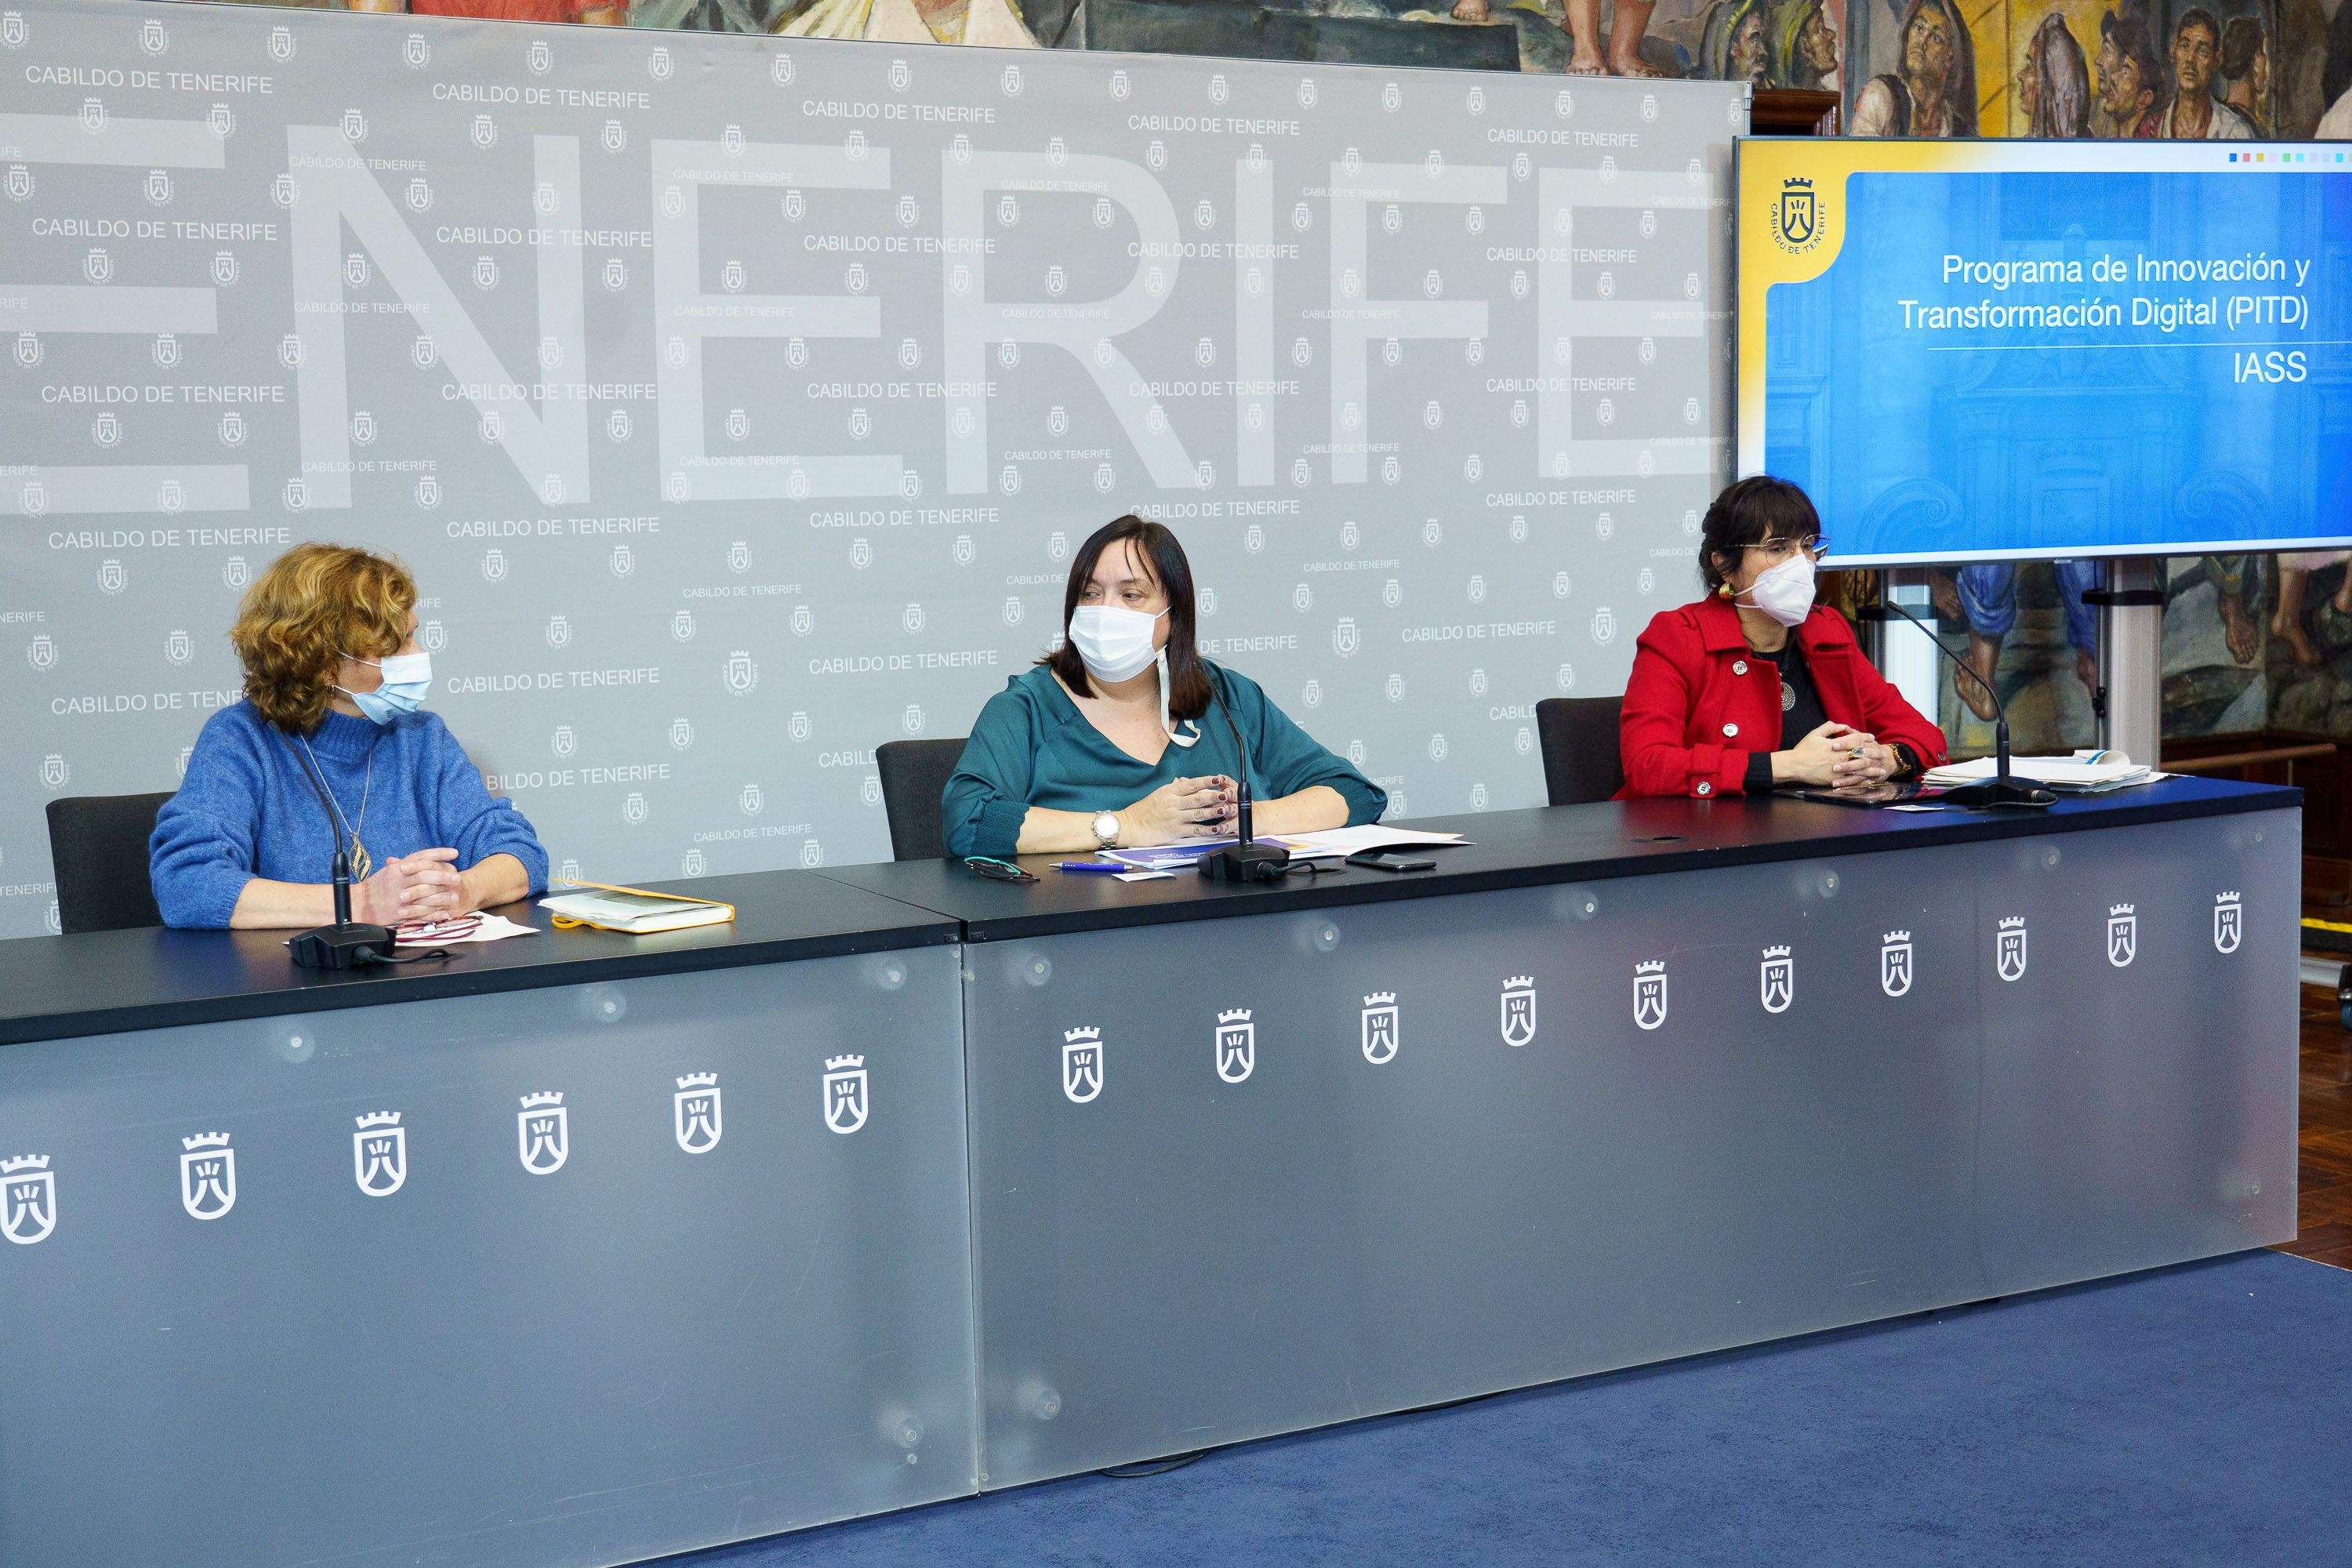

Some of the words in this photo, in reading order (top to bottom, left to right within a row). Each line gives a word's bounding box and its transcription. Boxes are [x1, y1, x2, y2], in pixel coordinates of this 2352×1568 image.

[24, 64, 125, 88] CABILDO
[130, 69, 162, 89] DE
[166, 71, 274, 95] TENERIFE
[432, 83, 520, 103] CABILDO
[524, 87, 552, 105] DE
[556, 89, 651, 109] TENERIFE
[802, 100, 880, 119] CABILDO
[884, 103, 908, 121] DE
[911, 104, 996, 124] TENERIFE
[1127, 114, 1197, 132] CABILDO
[1200, 117, 1222, 133] DE
[1225, 118, 1301, 136] TENERIFE
[1486, 128, 1548, 144] CABILDO
[1550, 129, 1570, 146] DE
[1573, 131, 1639, 148] TENERIFE
[289, 155, 344, 169] CABILDO
[347, 158, 364, 170] DE
[366, 158, 427, 172] TENERIFE
[670, 169, 722, 181] CABILDO
[723, 170, 740, 182] DE
[741, 170, 795, 183] TENERIFE
[1000, 179, 1046, 191] CABILDO
[1046, 180, 1061, 191] DE
[1062, 180, 1110, 192] TENERIFE
[1301, 187, 1341, 198] CABILDO
[1343, 187, 1356, 198] DE
[1358, 188, 1399, 199] TENERIFE
[31, 218, 130, 238] CABILDO
[136, 220, 167, 238] DE
[171, 221, 278, 241] TENERIFE
[435, 226, 523, 245] CABILDO
[528, 228, 554, 246] DE
[560, 229, 653, 248] TENERIFE
[1770, 202, 1787, 250] CABILDO
[1788, 245, 1800, 255] DE
[1802, 201, 1826, 254] TENERIFE
[803, 234, 881, 252] CABILDO
[884, 236, 909, 252] DE
[913, 236, 996, 254] TENERIFE
[1127, 241, 1197, 258] CABILDO
[1200, 242, 1221, 258] DE
[1224, 243, 1300, 260] TENERIFE
[1486, 247, 1547, 263] CABILDO
[1550, 247, 1568, 263] DE
[1572, 248, 1637, 263] TENERIFE
[1942, 254, 2083, 292] Programa
[2091, 253, 2128, 283] de
[2137, 252, 2287, 283] Innovación
[2294, 258, 2311, 288] y
[294, 301, 349, 314] CABILDO
[350, 302, 368, 314] DE
[370, 302, 430, 314] TENERIFE
[673, 306, 724, 317] CABILDO
[725, 306, 741, 318] DE
[742, 307, 796, 318] TENERIFE
[1001, 308, 1046, 319] CABILDO
[1046, 308, 1061, 319] DE
[1062, 308, 1110, 319] TENERIFE
[1301, 310, 1341, 319] CABILDO
[1342, 309, 1355, 319] DE
[1356, 309, 1399, 319] TENERIFE
[1897, 297, 2122, 329] Transformación
[2132, 296, 2217, 333] Digital
[2226, 295, 2310, 332] (PITD)
[2234, 351, 2307, 383] IASS
[441, 383, 528, 401] CABILDO
[532, 383, 559, 401] DE
[564, 383, 657, 400] TENERIFE
[806, 383, 884, 399] CABILDO
[887, 382, 911, 398] DE
[914, 382, 998, 397] TENERIFE
[1129, 381, 1198, 397] CABILDO
[1200, 380, 1222, 397] DE
[1225, 379, 1300, 395] TENERIFE
[1486, 378, 1546, 393] CABILDO
[1549, 376, 1568, 393] DE
[1571, 376, 1637, 391] TENERIFE
[40, 385, 139, 403] CABILDO
[144, 385, 175, 403] DE
[179, 385, 285, 403] TENERIFE
[1004, 450, 1048, 461] CABILDO
[1048, 449, 1063, 460] DE
[1064, 448, 1112, 459] TENERIFE
[1302, 445, 1341, 454] CABILDO
[1343, 443, 1355, 454] DE
[1357, 442, 1400, 452] TENERIFE
[302, 461, 356, 473] CABILDO
[358, 460, 376, 472] DE
[377, 459, 437, 471] TENERIFE
[679, 456, 728, 467] CABILDO
[729, 456, 746, 466] DE
[747, 456, 800, 466] TENERIFE
[0, 466, 38, 477] ERIFE
[1485, 491, 1547, 507] CABILDO
[1548, 491, 1568, 506] DE
[1570, 488, 1636, 505] TENERIFE
[808, 510, 886, 528] CABILDO
[889, 510, 913, 527] DE
[916, 506, 1000, 525] TENERIFE
[1129, 503, 1198, 520] CABILDO
[1201, 502, 1223, 517] DE
[1225, 499, 1301, 517] TENERIFE
[445, 519, 532, 539] CABILDO
[536, 518, 564, 536] DE
[567, 516, 660, 535] TENERIFE
[48, 530, 145, 550] CABILDO
[151, 529, 181, 547] DE
[186, 527, 291, 546] TENERIFE
[1302, 561, 1343, 572] CABILDO
[1343, 560, 1356, 572] DE
[1357, 558, 1400, 570] TENERIFE
[1006, 575, 1049, 585] CABILDO
[1051, 573, 1065, 583] DE
[682, 586, 731, 599] CABILDO
[732, 585, 749, 597] DE
[750, 583, 803, 596] TENERIFE
[414, 597, 442, 609] RIFE
[0, 611, 46, 623] NERIFE
[1401, 625, 1464, 643] CABILDO
[1466, 624, 1486, 640] DE
[1488, 619, 1556, 637] TENERIFE
[1199, 638, 1221, 655] DE
[1224, 634, 1298, 653] TENERIFE
[808, 655, 885, 675] CABILDO
[888, 654, 913, 671] DE
[916, 649, 998, 669] TENERIFE
[447, 673, 532, 695] CABILDO
[537, 671, 564, 689] DE
[568, 666, 660, 688] TENERIFE
[50, 694, 147, 715] CABILDO
[153, 691, 183, 710] DE
[187, 689, 242, 711] TENE
[1489, 705, 1537, 720] CABILD
[818, 750, 877, 768] CABILD
[485, 771, 544, 791] BILDO
[548, 768, 575, 787] DE
[579, 763, 671, 785] TENERIFE
[1372, 775, 1405, 785] NERIFE
[692, 829, 741, 843] CABILDO
[742, 827, 758, 839] DE
[760, 823, 812, 837] TENERIFE
[0, 882, 57, 896] TENERIF
